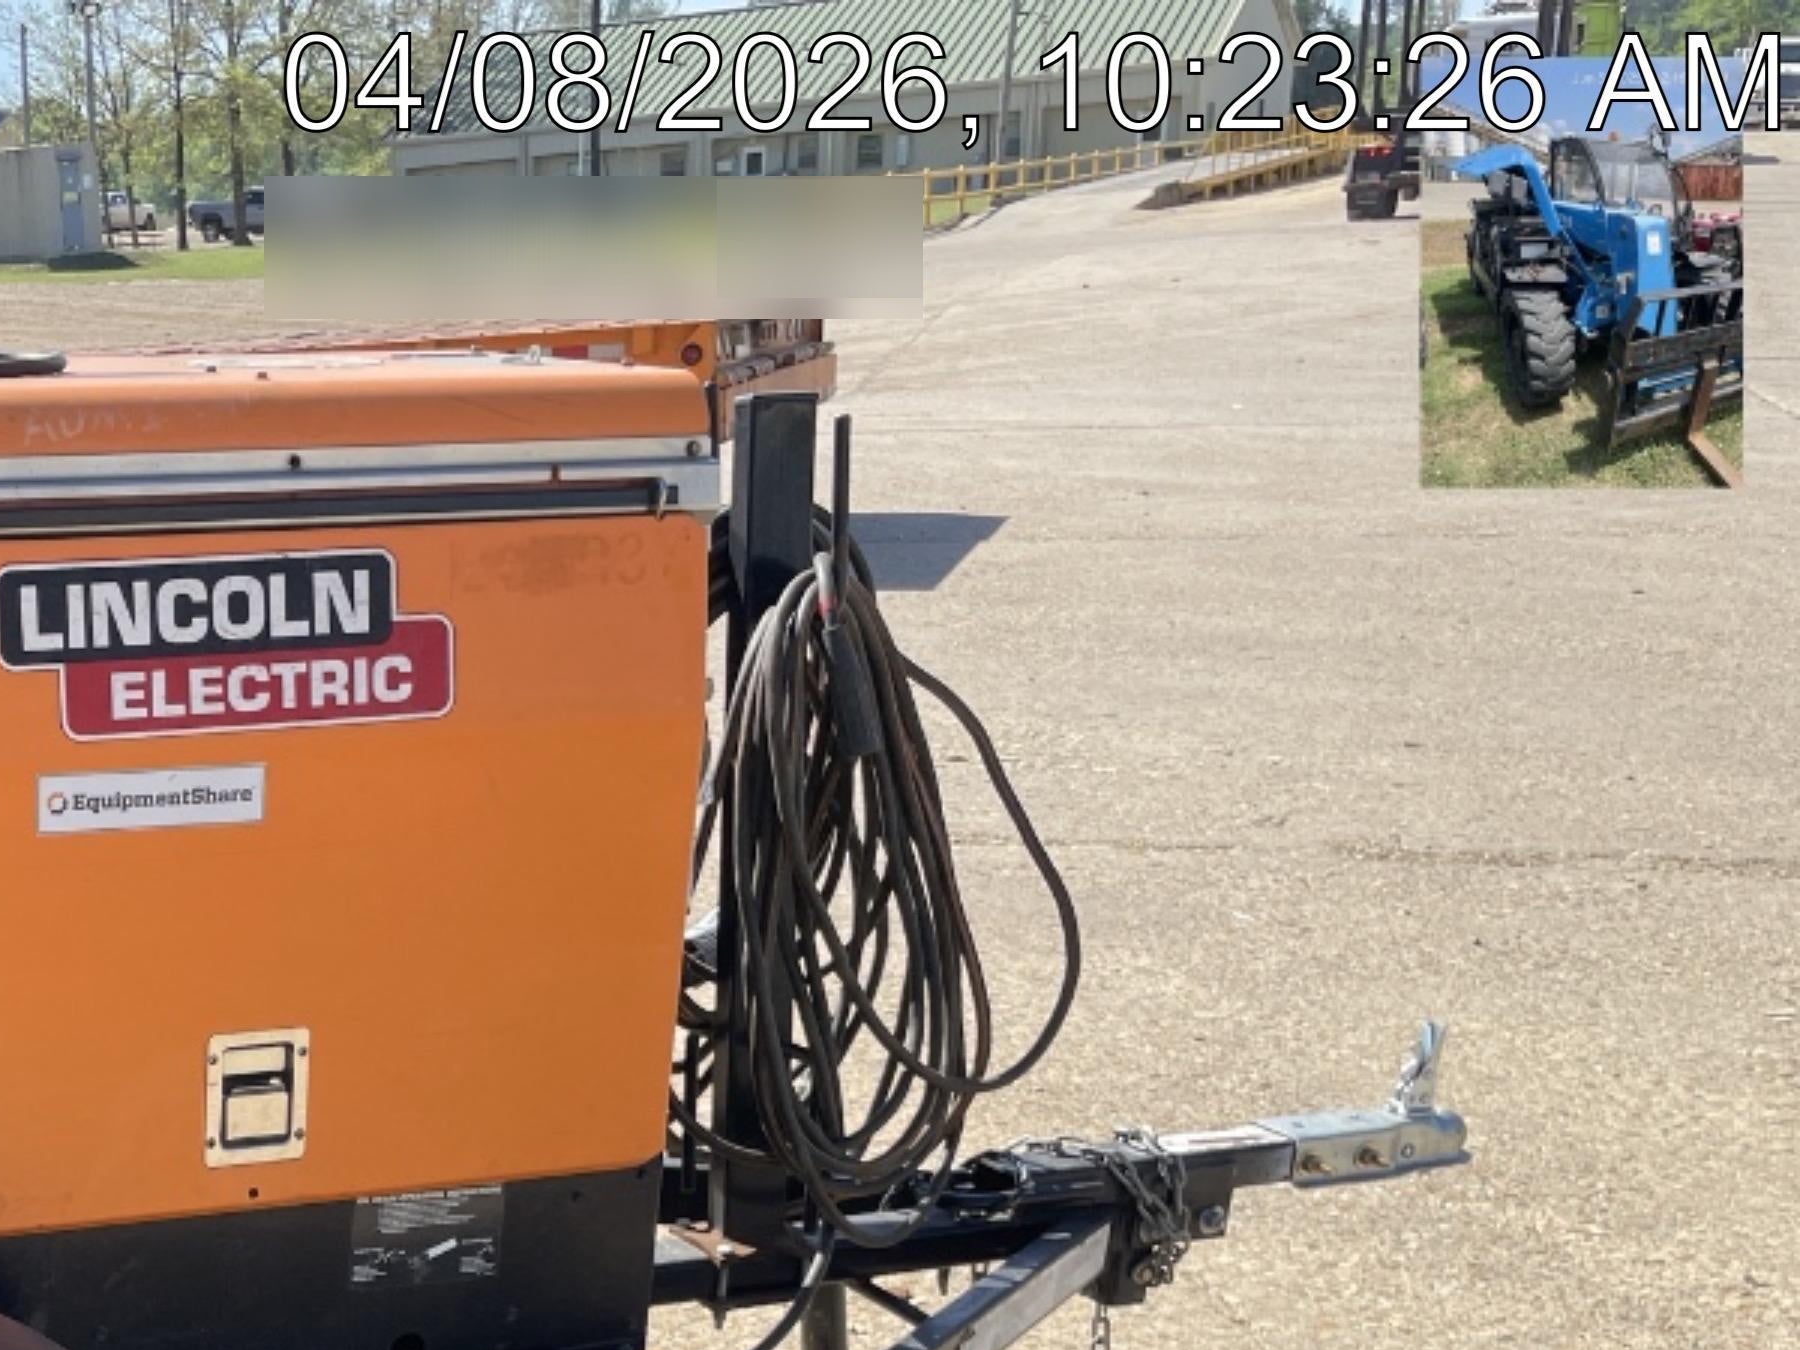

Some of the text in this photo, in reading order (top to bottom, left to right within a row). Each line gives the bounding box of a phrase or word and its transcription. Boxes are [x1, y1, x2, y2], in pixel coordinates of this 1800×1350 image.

[20, 569, 371, 653] LINCOLN
[110, 654, 414, 721] ELECTRIC
[71, 785, 255, 813] EquipmentShare
